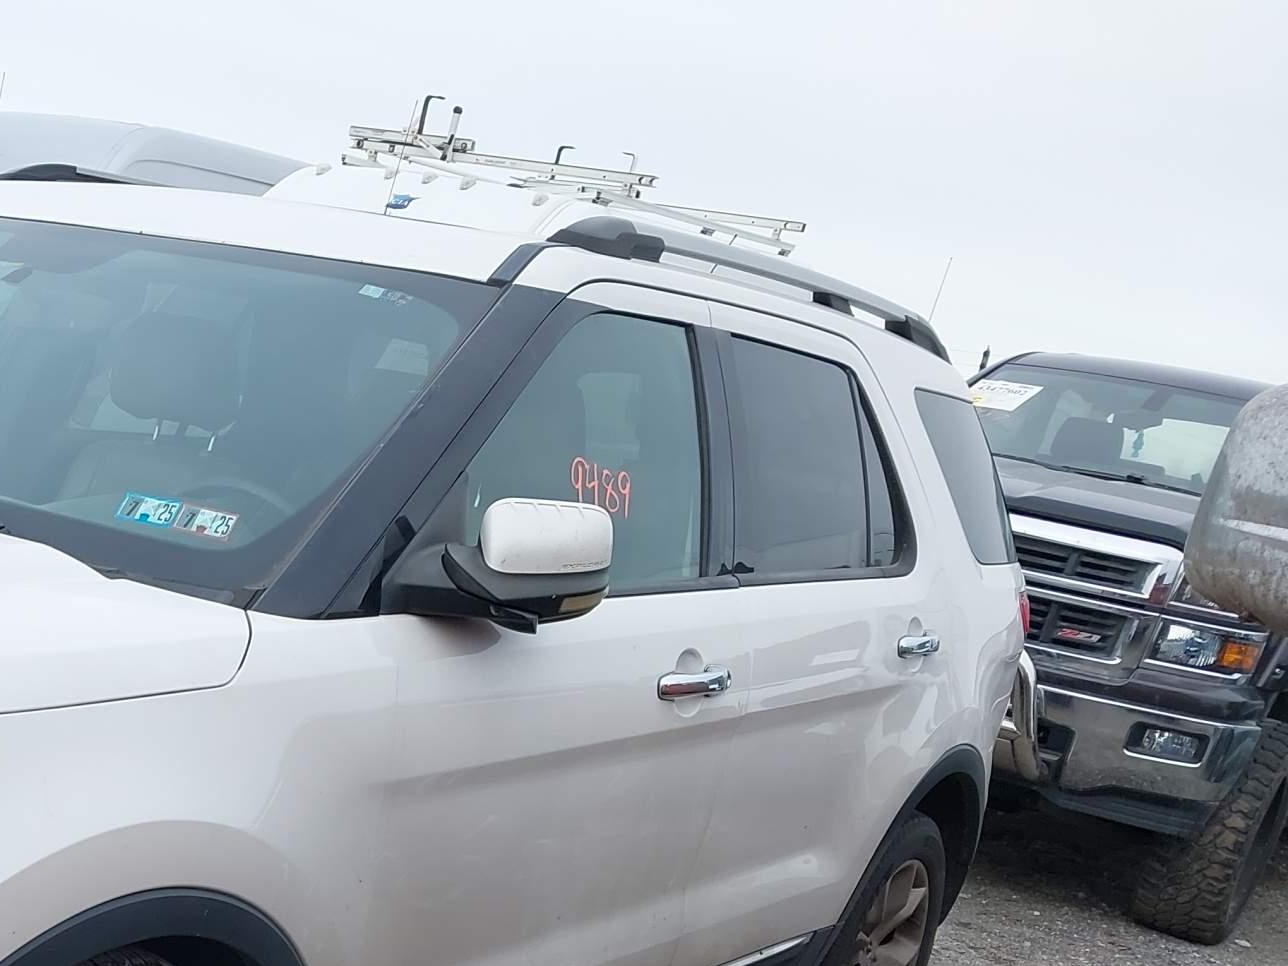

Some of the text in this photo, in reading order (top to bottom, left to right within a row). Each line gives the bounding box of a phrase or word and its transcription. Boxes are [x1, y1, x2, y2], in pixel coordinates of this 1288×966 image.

[571, 456, 631, 519] 9489
[157, 503, 177, 523] 25
[214, 515, 234, 536] 25
